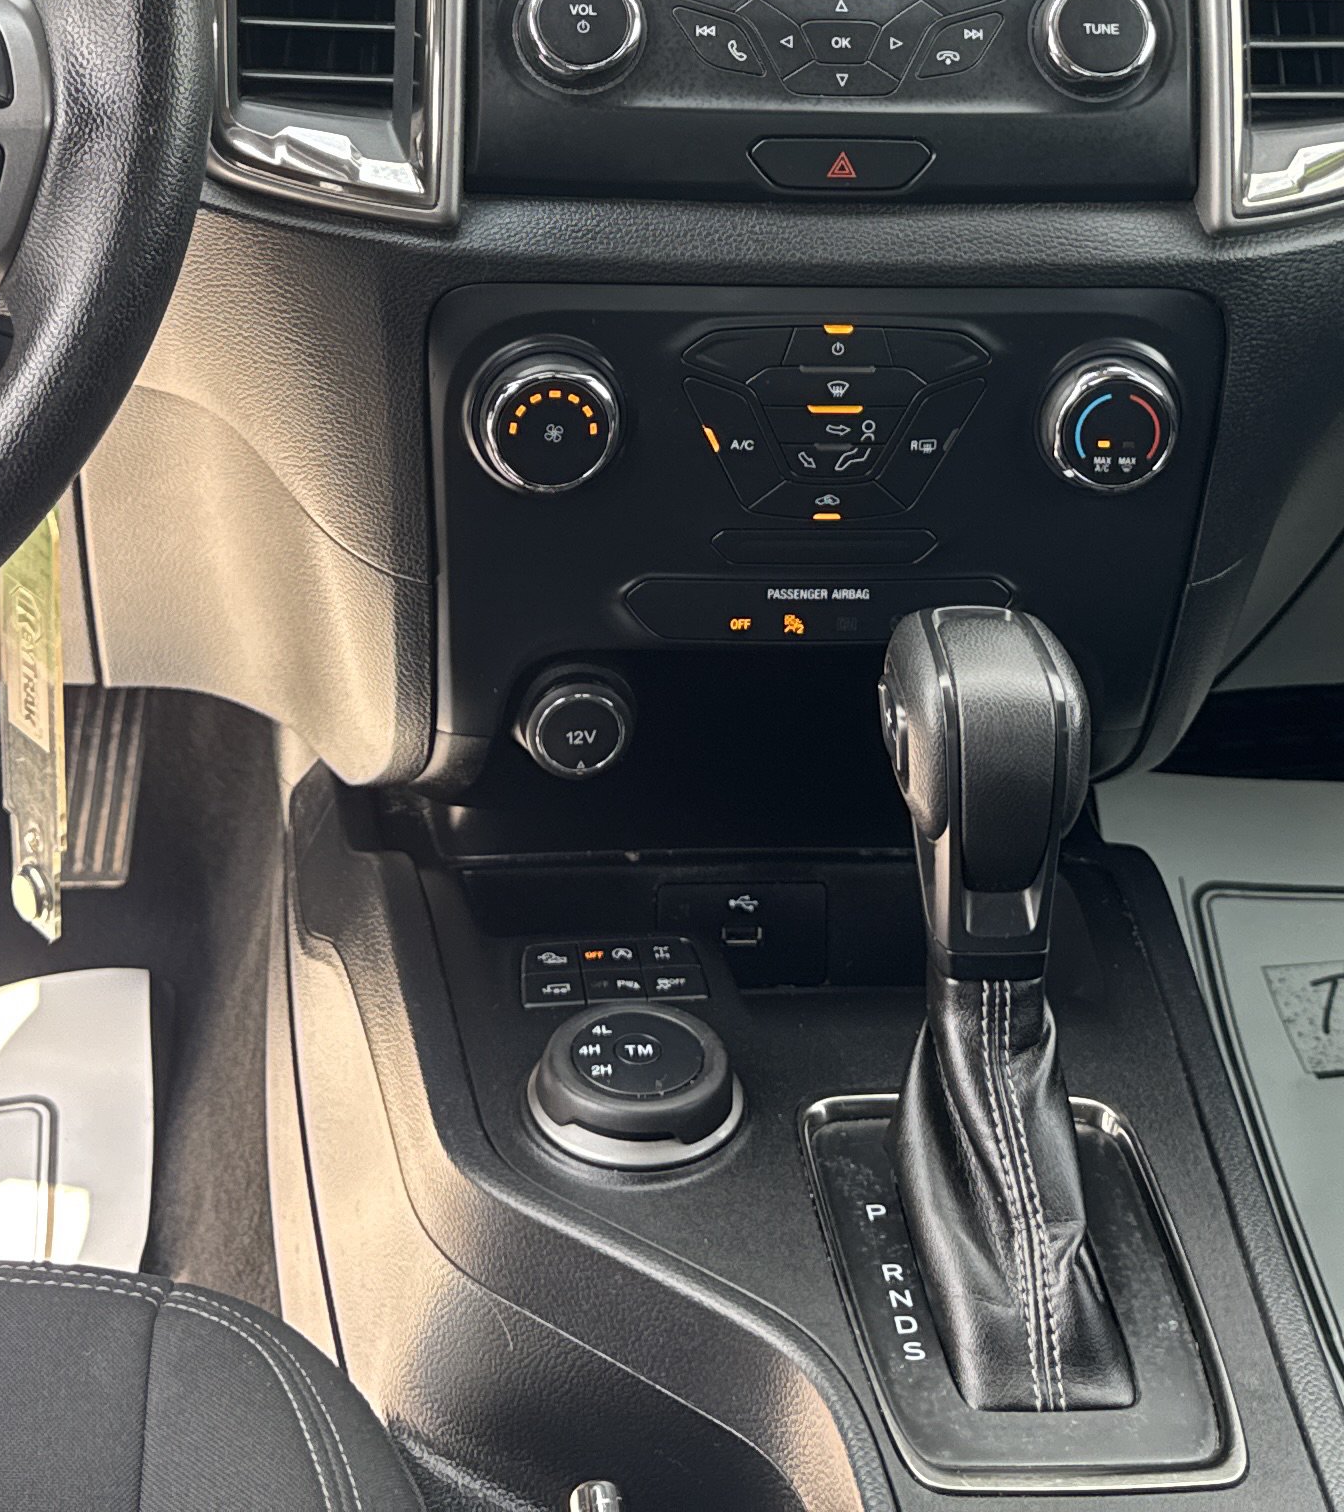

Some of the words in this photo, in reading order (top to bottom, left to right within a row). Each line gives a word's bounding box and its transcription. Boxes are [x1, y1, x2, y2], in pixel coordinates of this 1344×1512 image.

[569, 4, 597, 16] VOL
[1083, 23, 1120, 35] TUNE
[831, 37, 851, 49] OK
[730, 440, 754, 451] A/C
[1094, 456, 1112, 465] MAX
[1118, 457, 1136, 465] MAX
[1095, 464, 1109, 473] A/C
[767, 588, 828, 600] PASSENGER
[831, 589, 870, 600] AIRBAG
[729, 618, 752, 630] OFF
[566, 729, 597, 745] 12V
[584, 951, 604, 960] OFF
[592, 1025, 612, 1036] 4L
[579, 1044, 601, 1056] 4H
[624, 1044, 654, 1057] TM
[591, 1064, 612, 1076] 2H
[865, 1204, 887, 1222] P
[882, 1264, 904, 1282] R
[889, 1289, 914, 1308] N
[894, 1316, 918, 1335] D
[903, 1342, 926, 1361] S
